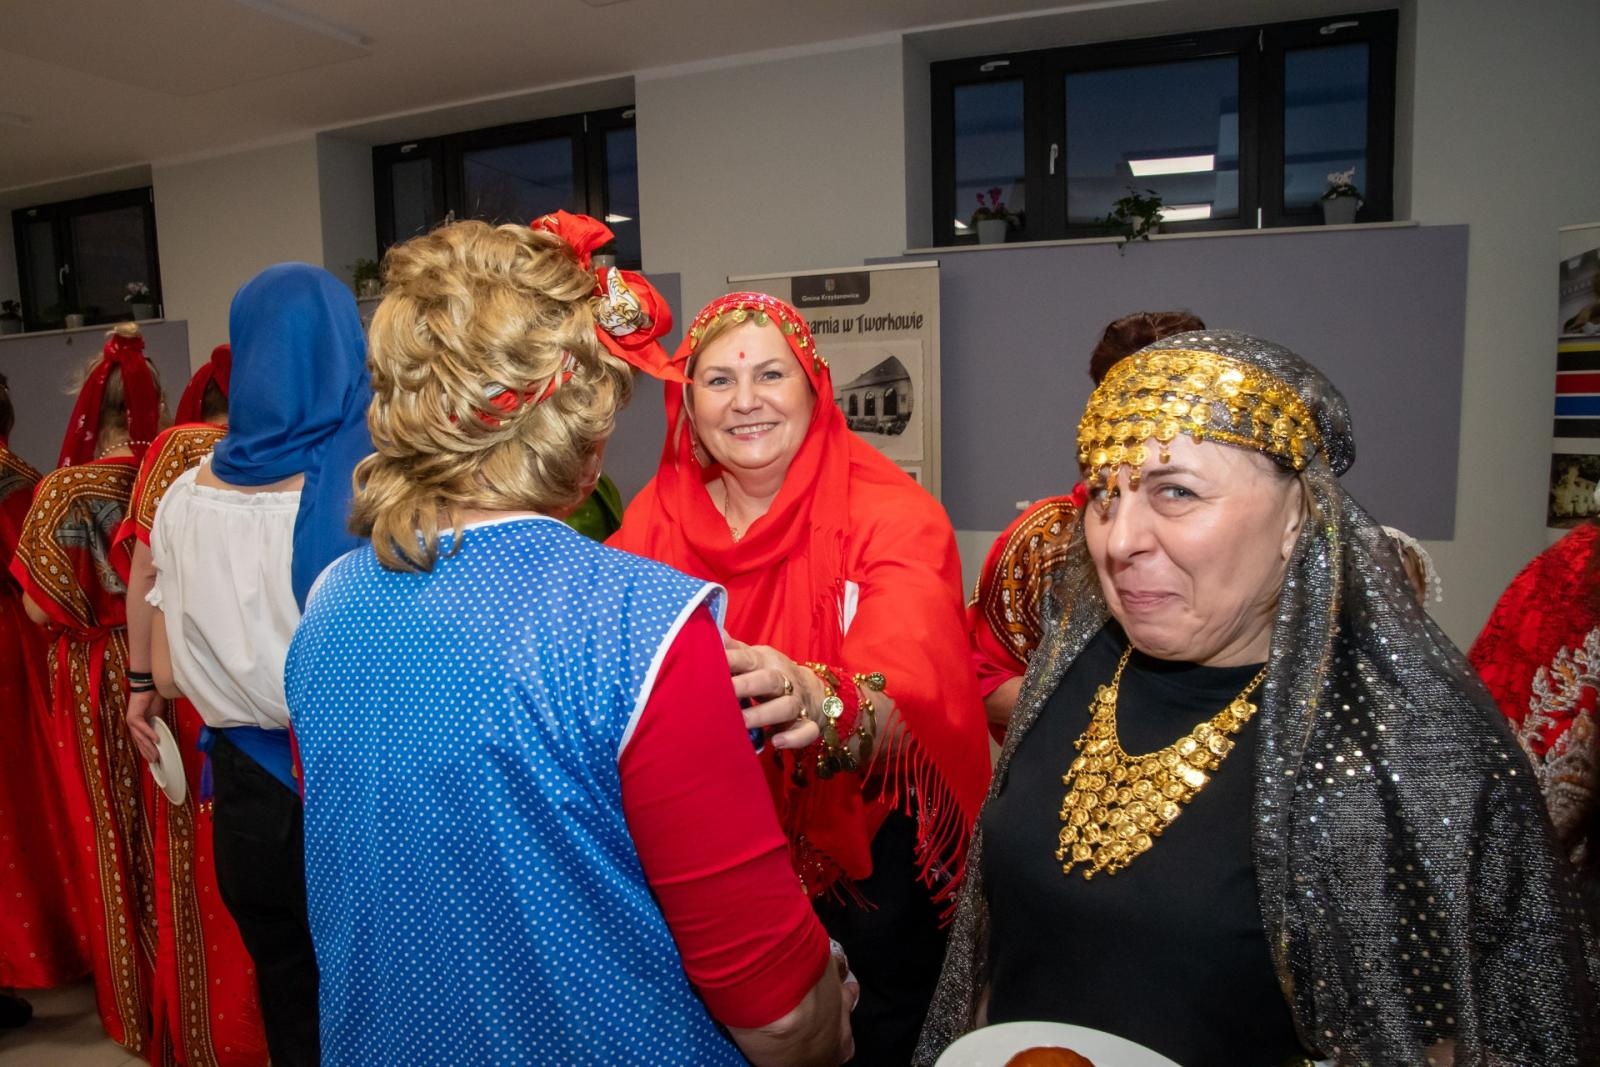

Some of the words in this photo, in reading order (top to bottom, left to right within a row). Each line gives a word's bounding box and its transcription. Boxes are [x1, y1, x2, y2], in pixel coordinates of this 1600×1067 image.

[807, 316, 840, 334] arnia
[843, 318, 854, 333] w
[856, 311, 924, 335] Tworkowie
